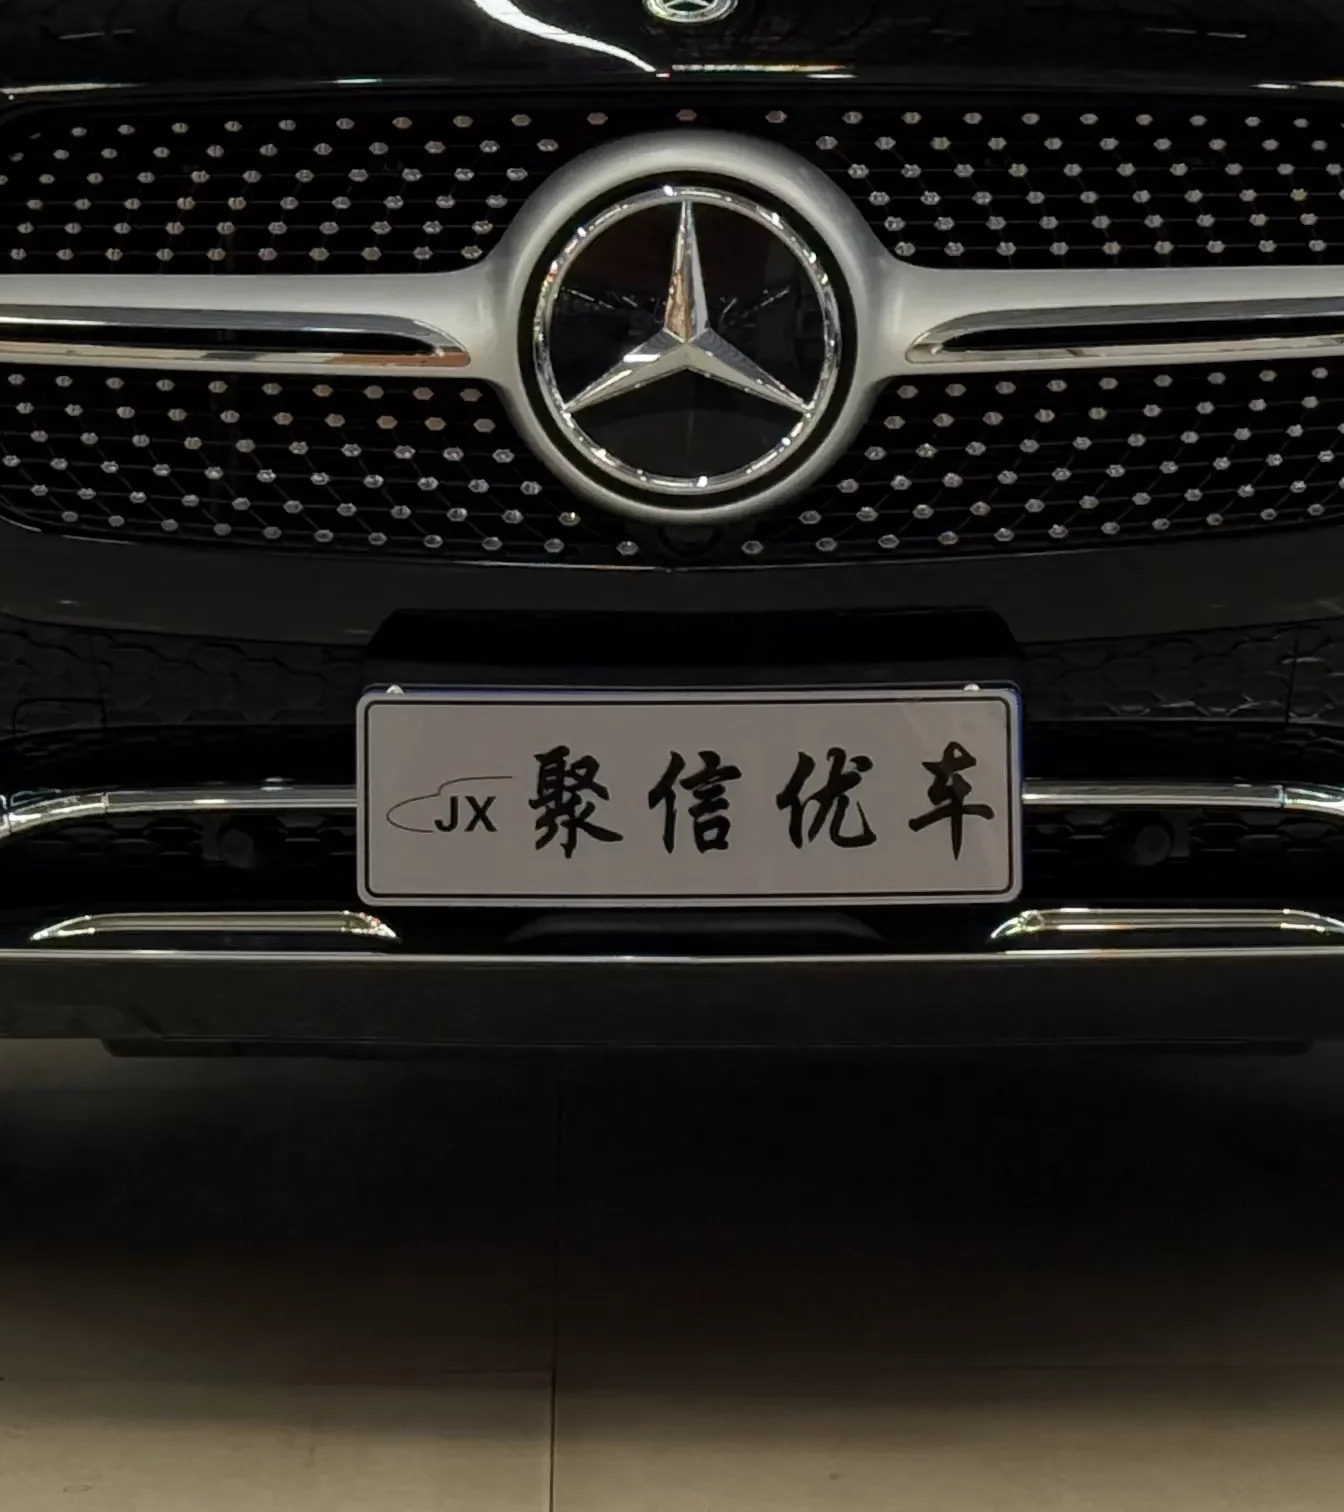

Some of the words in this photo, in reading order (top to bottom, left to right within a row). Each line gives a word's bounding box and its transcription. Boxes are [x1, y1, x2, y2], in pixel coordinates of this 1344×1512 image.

[433, 795, 498, 833] JX
[528, 741, 996, 861] 聚信优车
